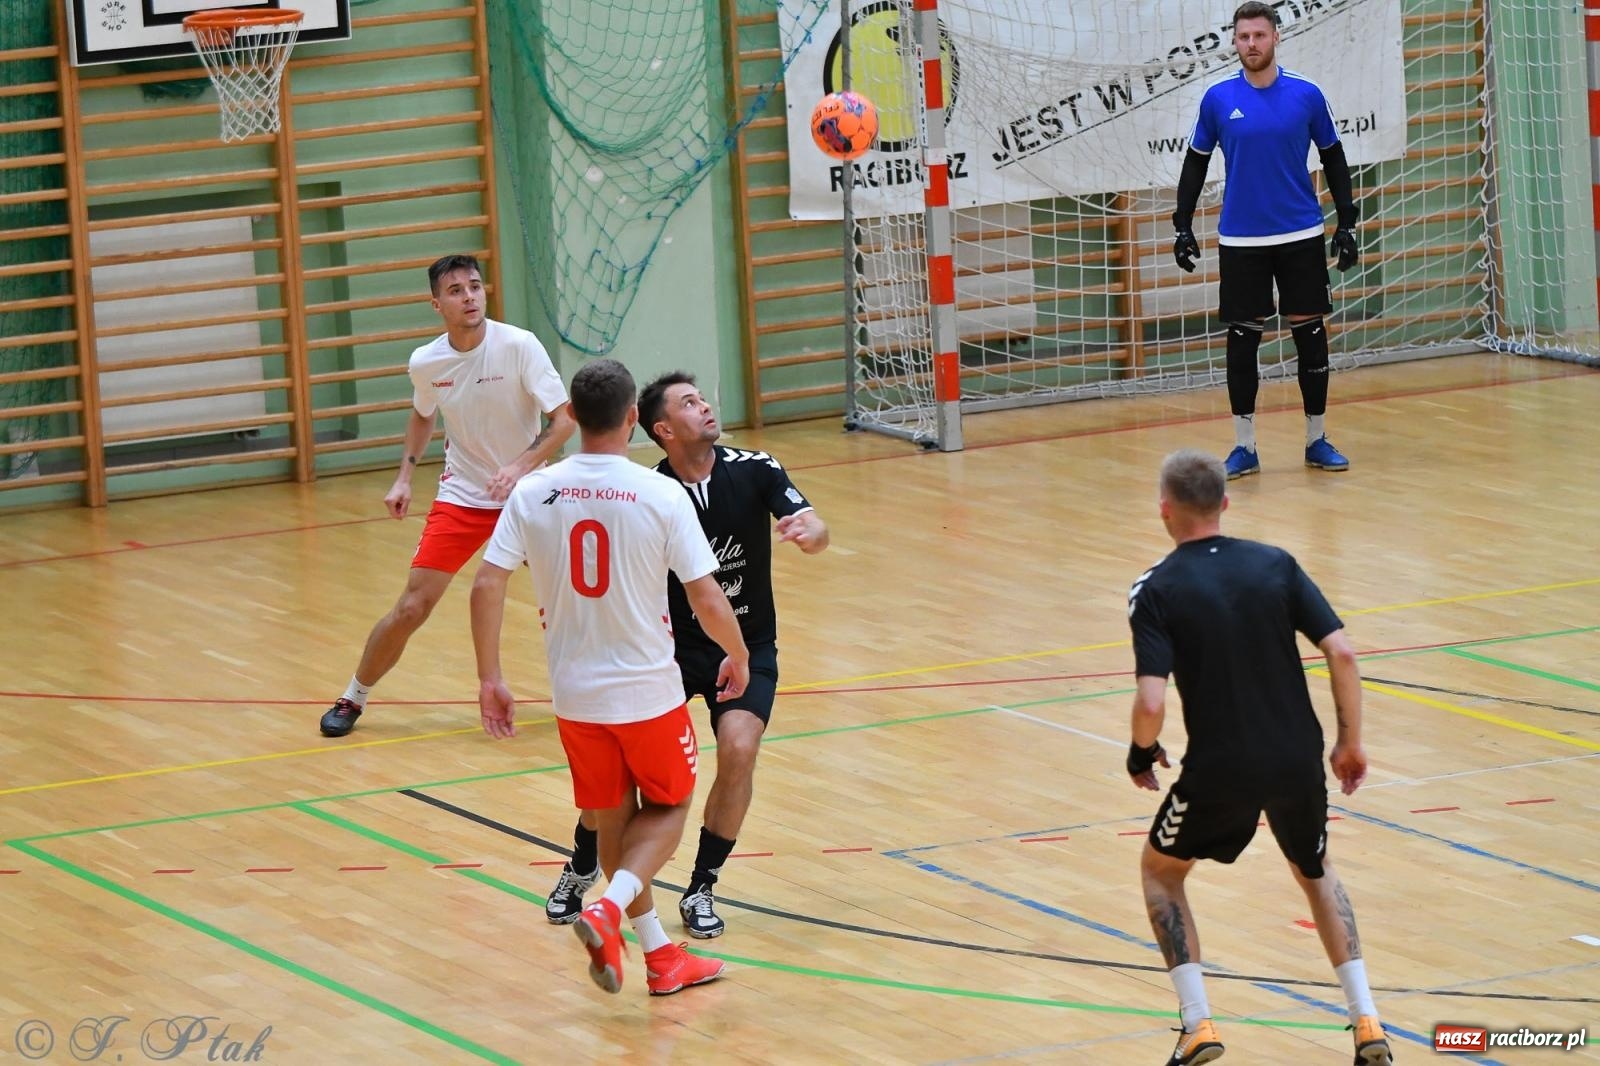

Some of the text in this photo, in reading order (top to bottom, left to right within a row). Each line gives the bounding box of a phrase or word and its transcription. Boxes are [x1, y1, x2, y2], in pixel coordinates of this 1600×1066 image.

[101, 1, 126, 13] SURE
[101, 19, 127, 31] SHOT
[991, 92, 1083, 162] JEST
[1093, 72, 1133, 114] W
[561, 487, 591, 499] PRD
[569, 518, 610, 599] 0
